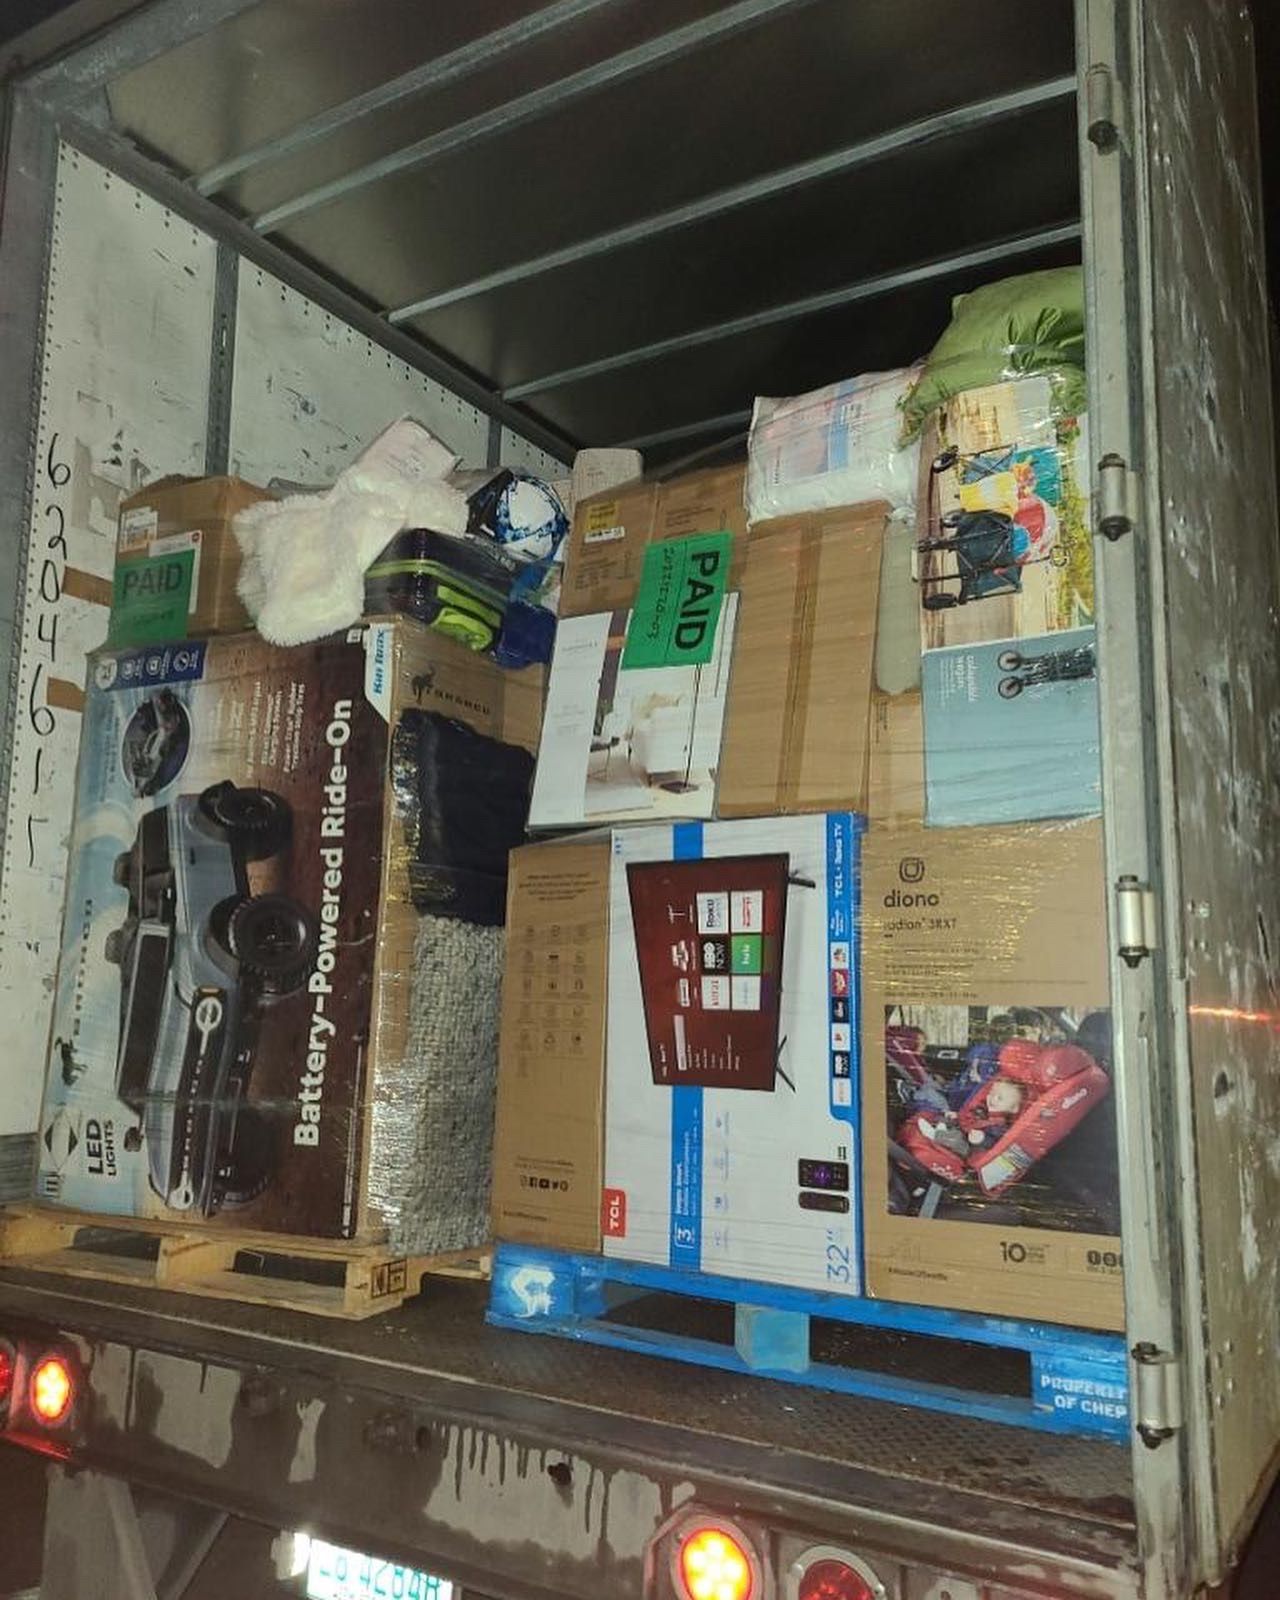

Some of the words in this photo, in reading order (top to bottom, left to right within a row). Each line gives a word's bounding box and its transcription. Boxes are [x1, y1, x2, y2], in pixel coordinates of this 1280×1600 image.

[122, 562, 184, 600] PAID
[674, 550, 720, 650] PAID
[834, 872, 843, 898] TCL
[294, 847, 344, 1147] Battery-Powered
[321, 700, 352, 838] Ride-On
[86, 1118, 104, 1176] LED
[103, 1119, 117, 1177] LIGHTS
[610, 1195, 620, 1230] TCL
[677, 1228, 692, 1241] 3
[1000, 1241, 1027, 1263] 10
[1054, 1395, 1077, 1409] OF
[1081, 1400, 1127, 1419] CHEP
